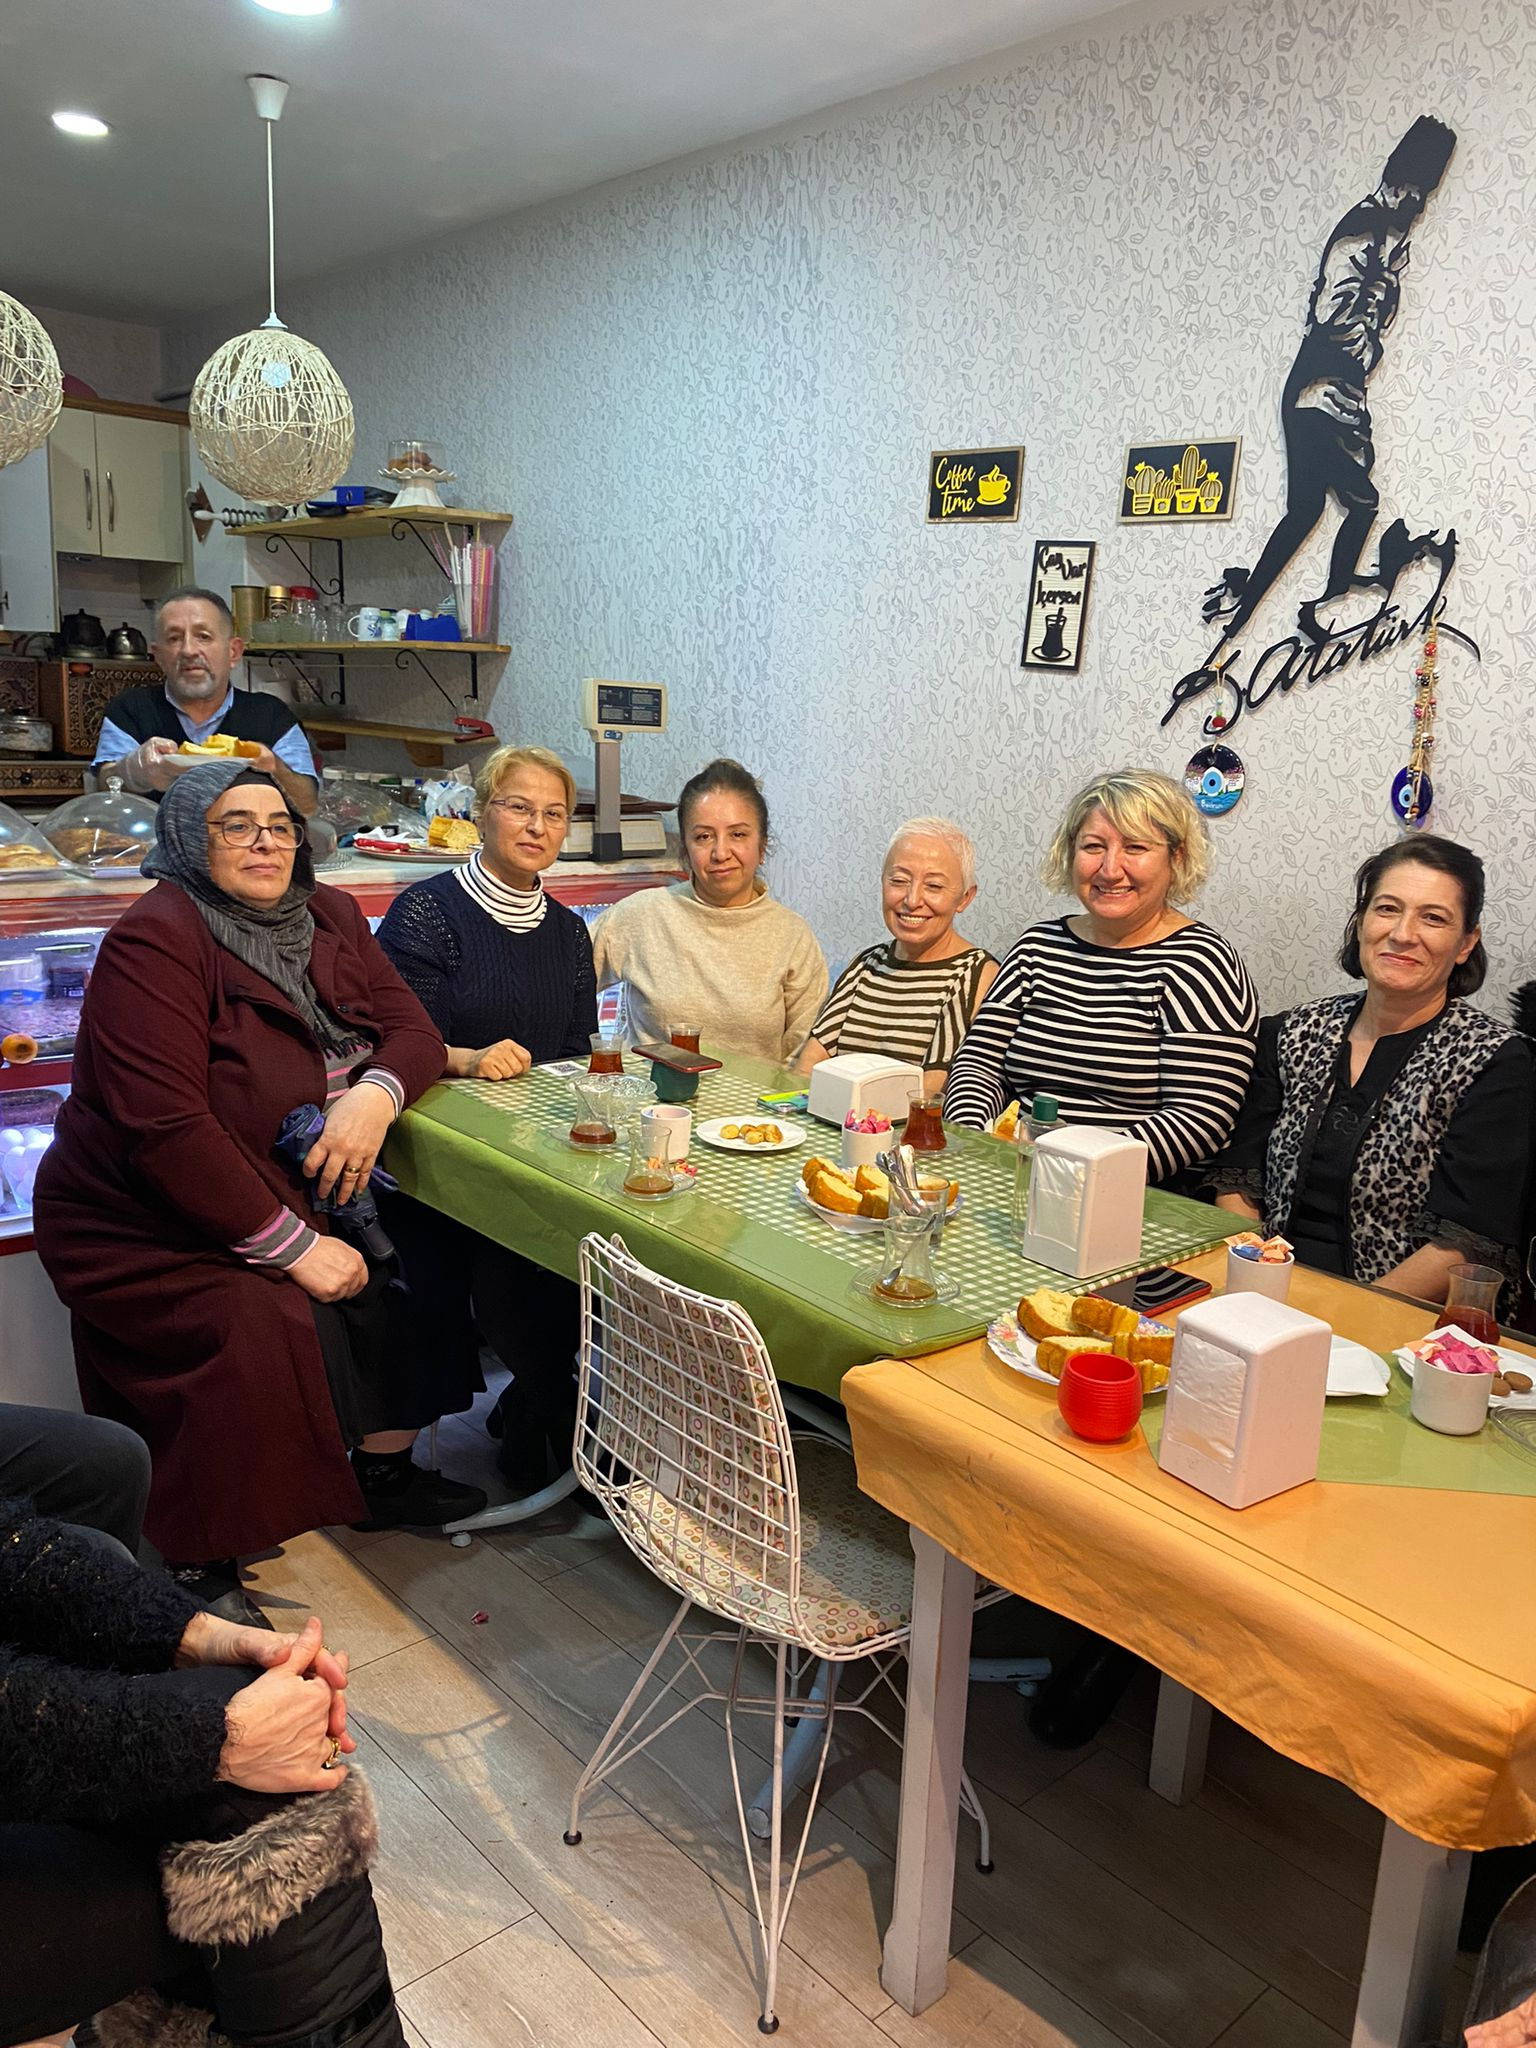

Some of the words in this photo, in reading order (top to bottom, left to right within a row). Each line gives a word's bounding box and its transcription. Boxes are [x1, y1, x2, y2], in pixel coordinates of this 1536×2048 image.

[936, 457, 976, 490] Coffee
[941, 485, 976, 517] time
[1062, 558, 1087, 580] Var
